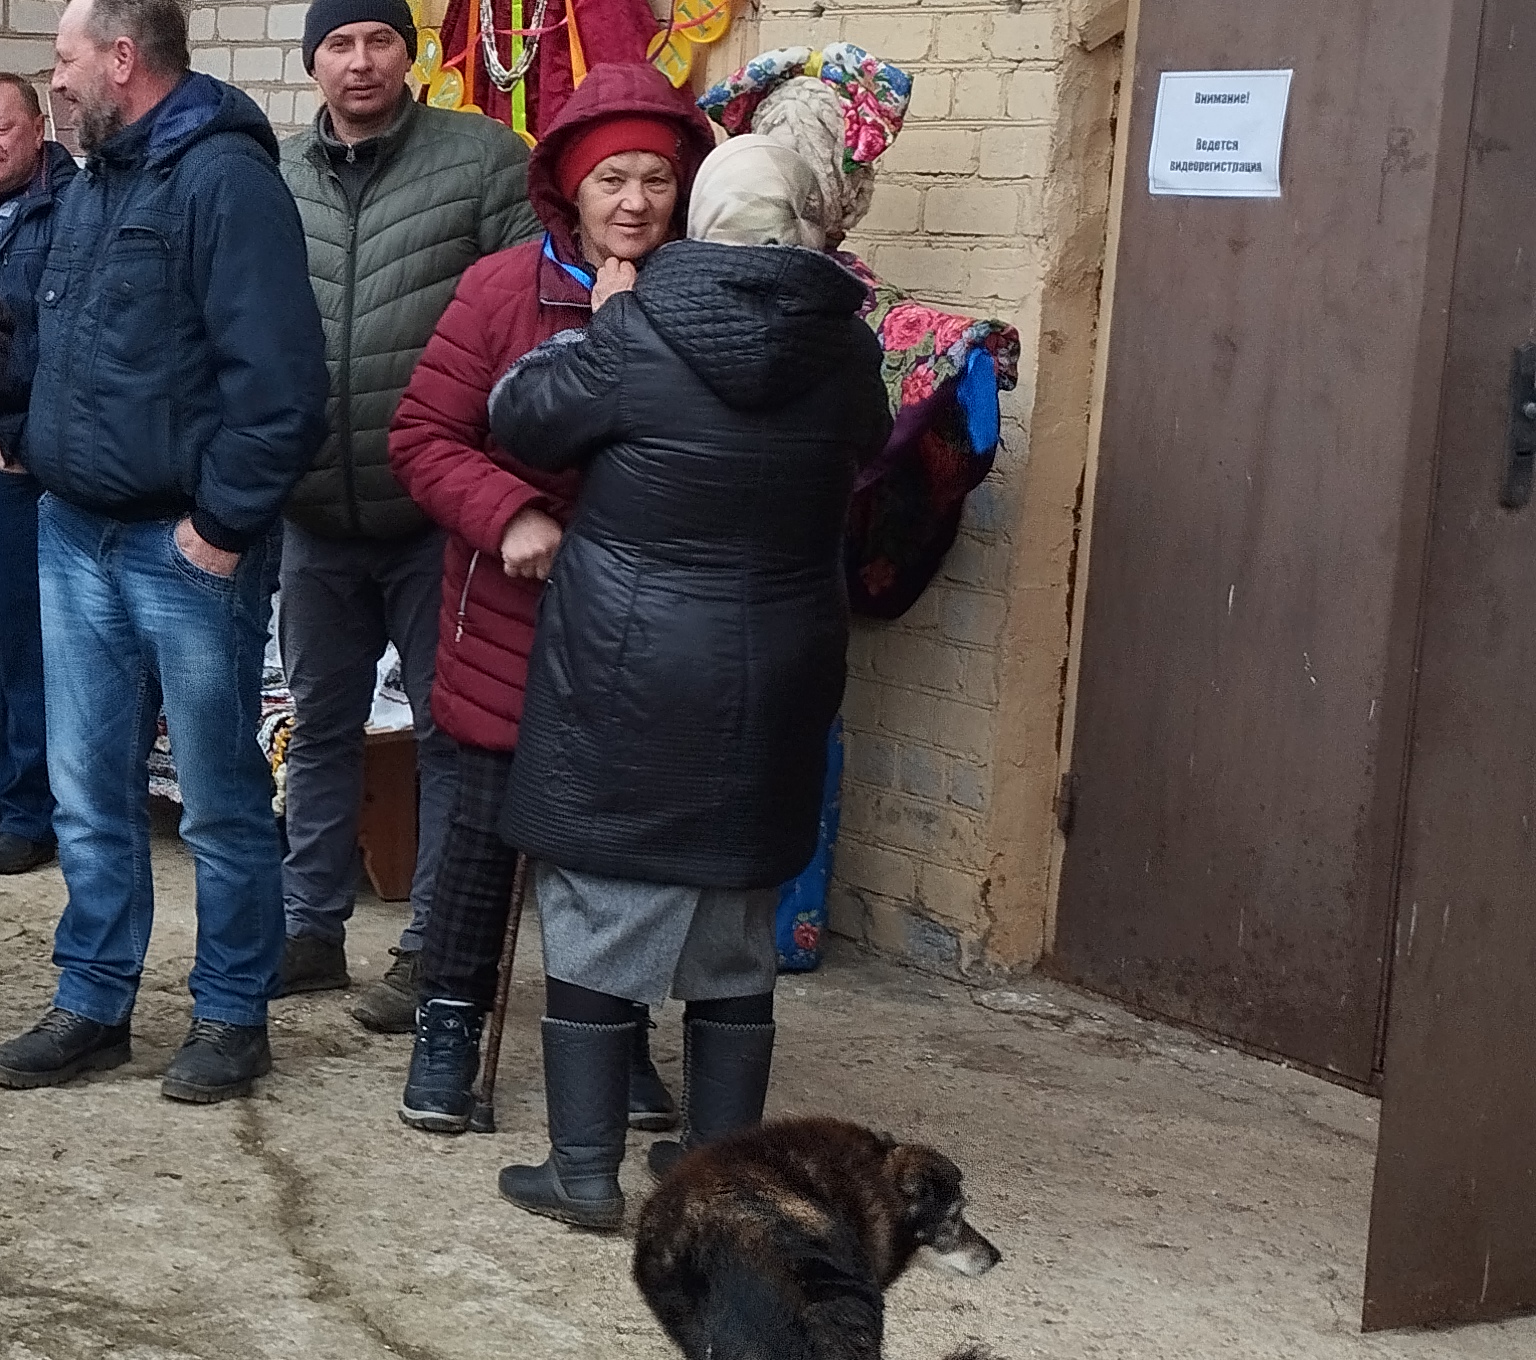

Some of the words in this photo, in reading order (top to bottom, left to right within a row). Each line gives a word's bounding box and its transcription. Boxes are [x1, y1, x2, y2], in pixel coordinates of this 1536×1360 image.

[1194, 91, 1251, 104] Внимание!
[1195, 137, 1239, 151] Ведется
[1169, 160, 1262, 173] видеорегистрация
